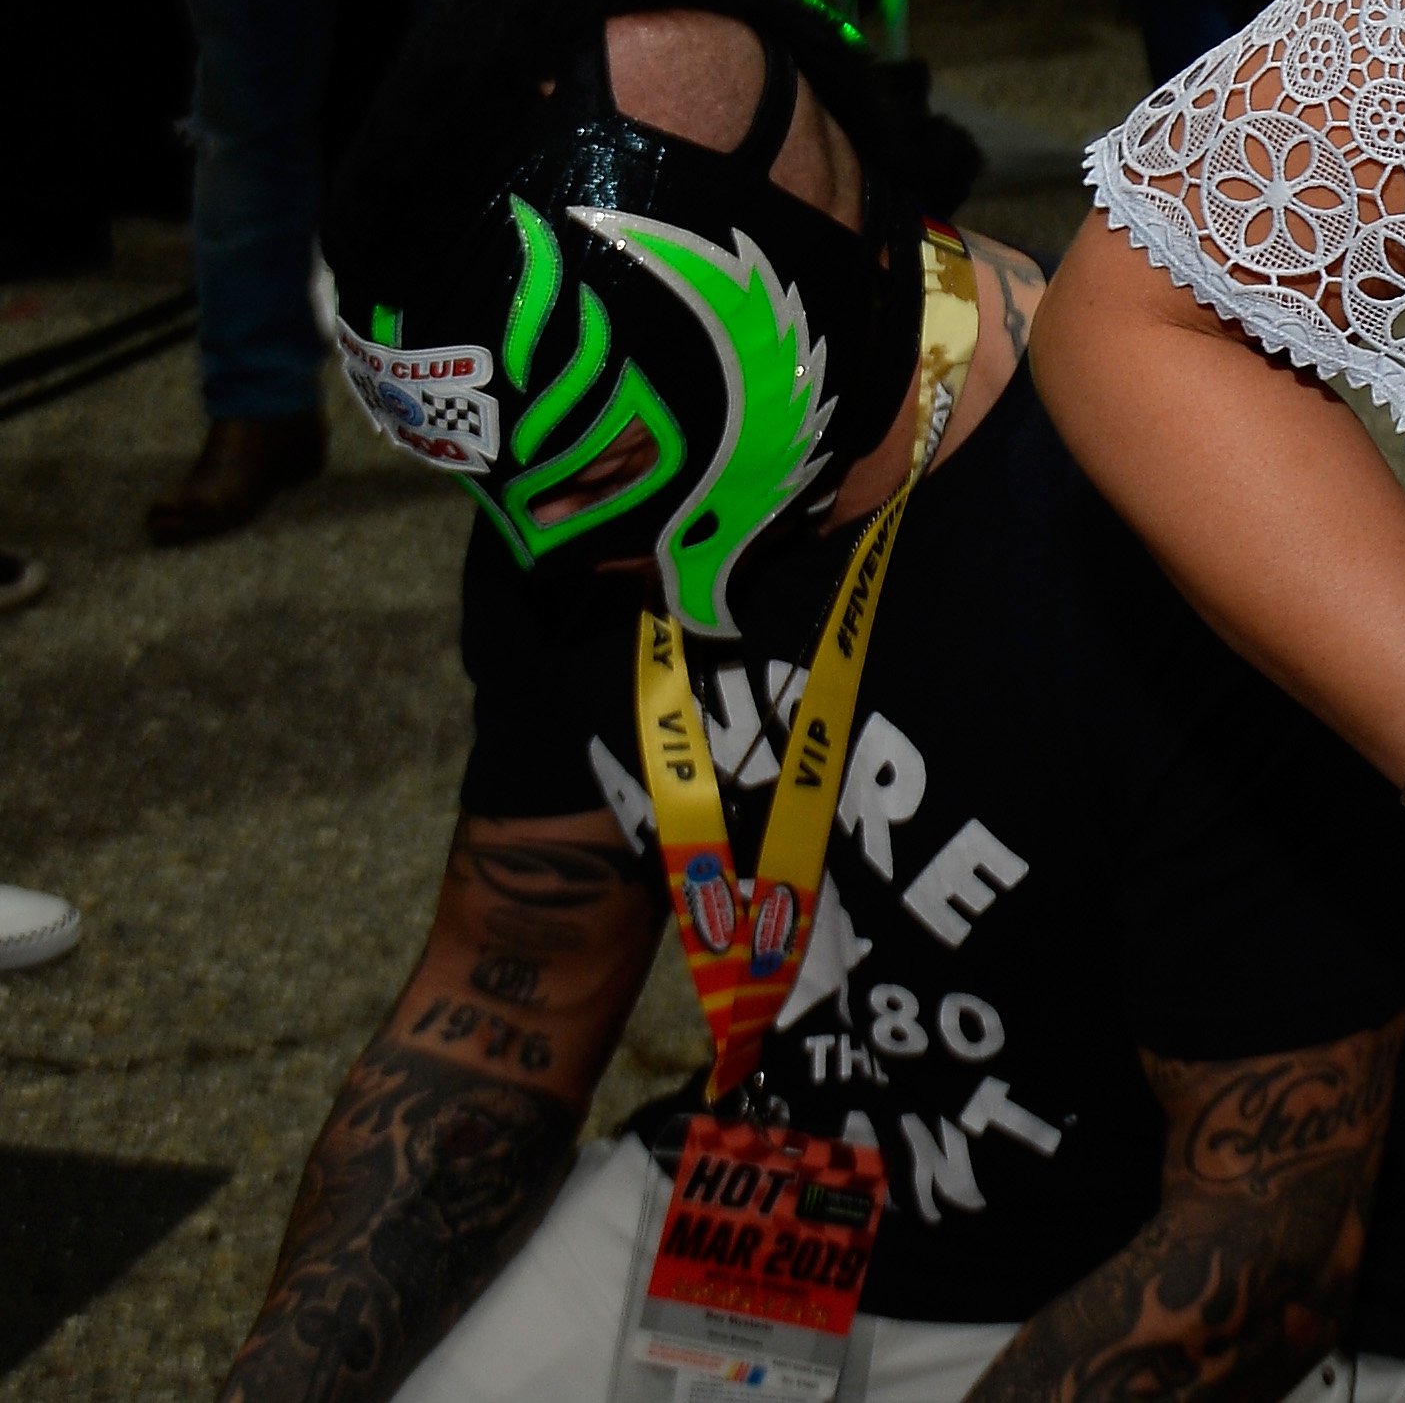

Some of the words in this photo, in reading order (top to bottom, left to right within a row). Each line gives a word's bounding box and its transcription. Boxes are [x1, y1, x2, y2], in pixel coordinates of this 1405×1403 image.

[391, 356, 477, 380] CLUB
[658, 709, 697, 782] VIP
[795, 716, 832, 789] VIP
[683, 1154, 800, 1215] HOT
[665, 1211, 763, 1270] MAR
[764, 1230, 867, 1290] 2019
